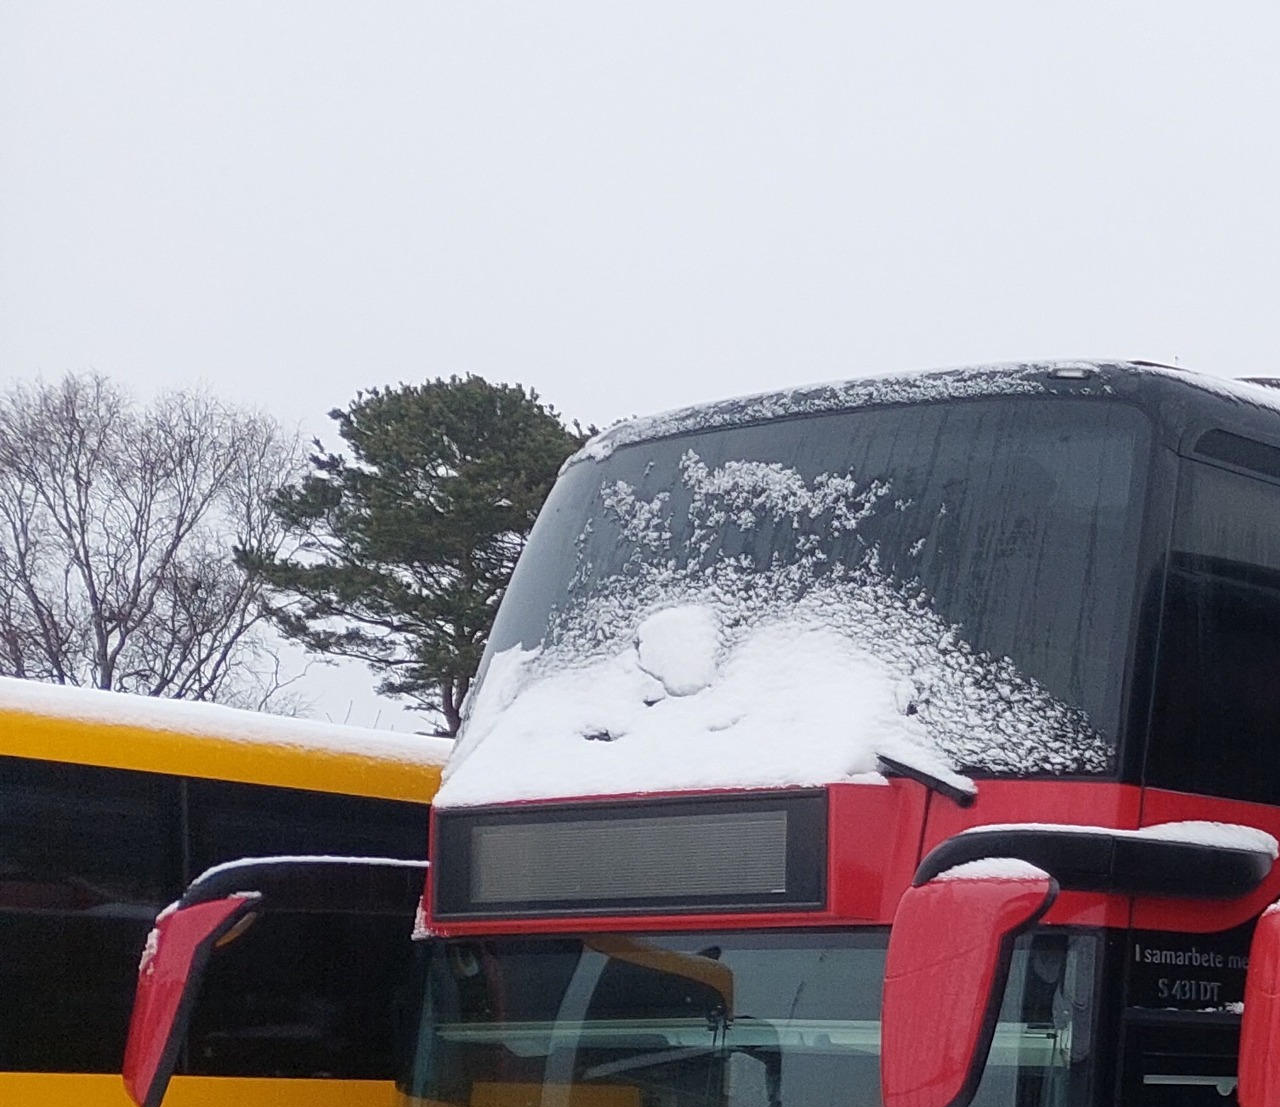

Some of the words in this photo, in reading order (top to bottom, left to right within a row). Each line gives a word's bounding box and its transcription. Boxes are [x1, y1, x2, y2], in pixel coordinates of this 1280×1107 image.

[1134, 943, 1142, 963] I
[1144, 947, 1224, 968] samarbete
[1157, 977, 1169, 998] S
[1171, 979, 1196, 1001] 431
[1198, 981, 1222, 1002] DT
